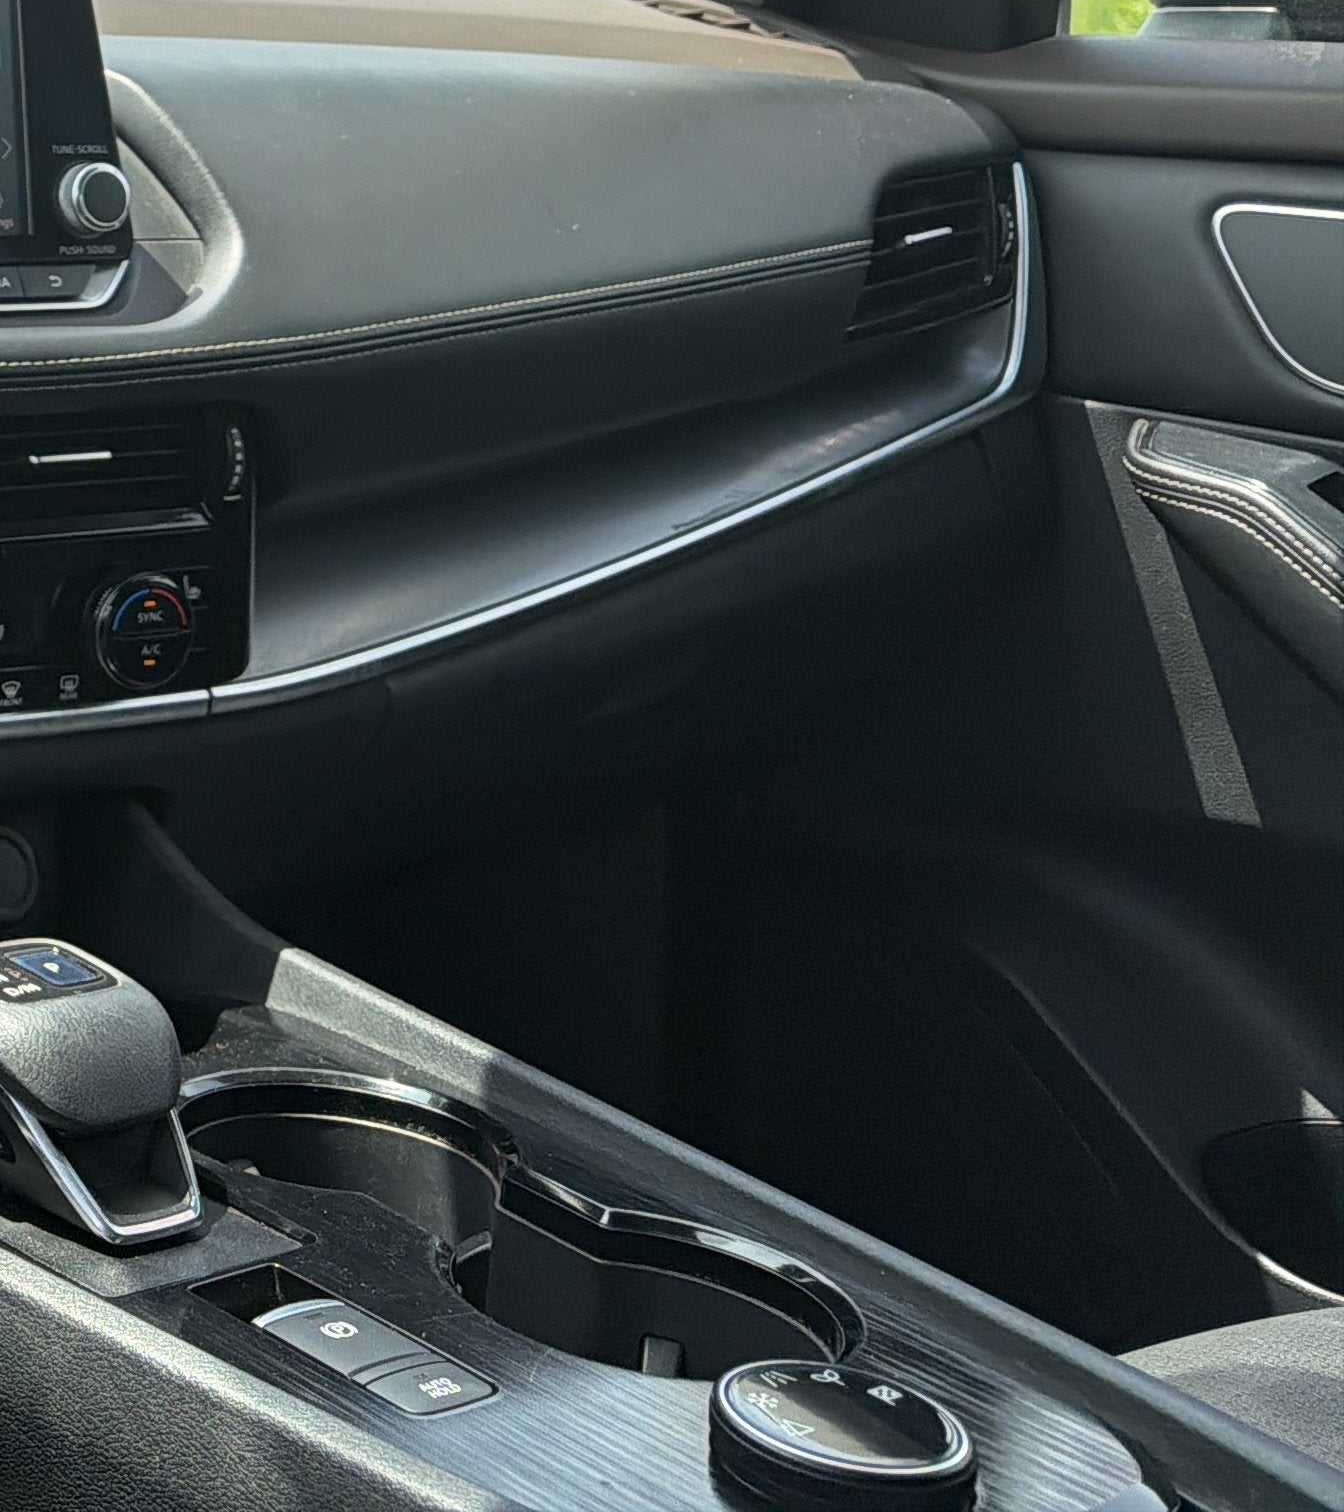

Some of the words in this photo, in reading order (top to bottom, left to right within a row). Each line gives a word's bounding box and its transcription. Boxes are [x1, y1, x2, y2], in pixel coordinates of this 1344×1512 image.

[86, 244, 117, 255] SOUND
[137, 611, 163, 624] SYNC
[141, 644, 161, 656] A/C
[42, 961, 60, 973] P
[418, 1376, 453, 1392] AUTO
[426, 1382, 462, 1399] HOLD
